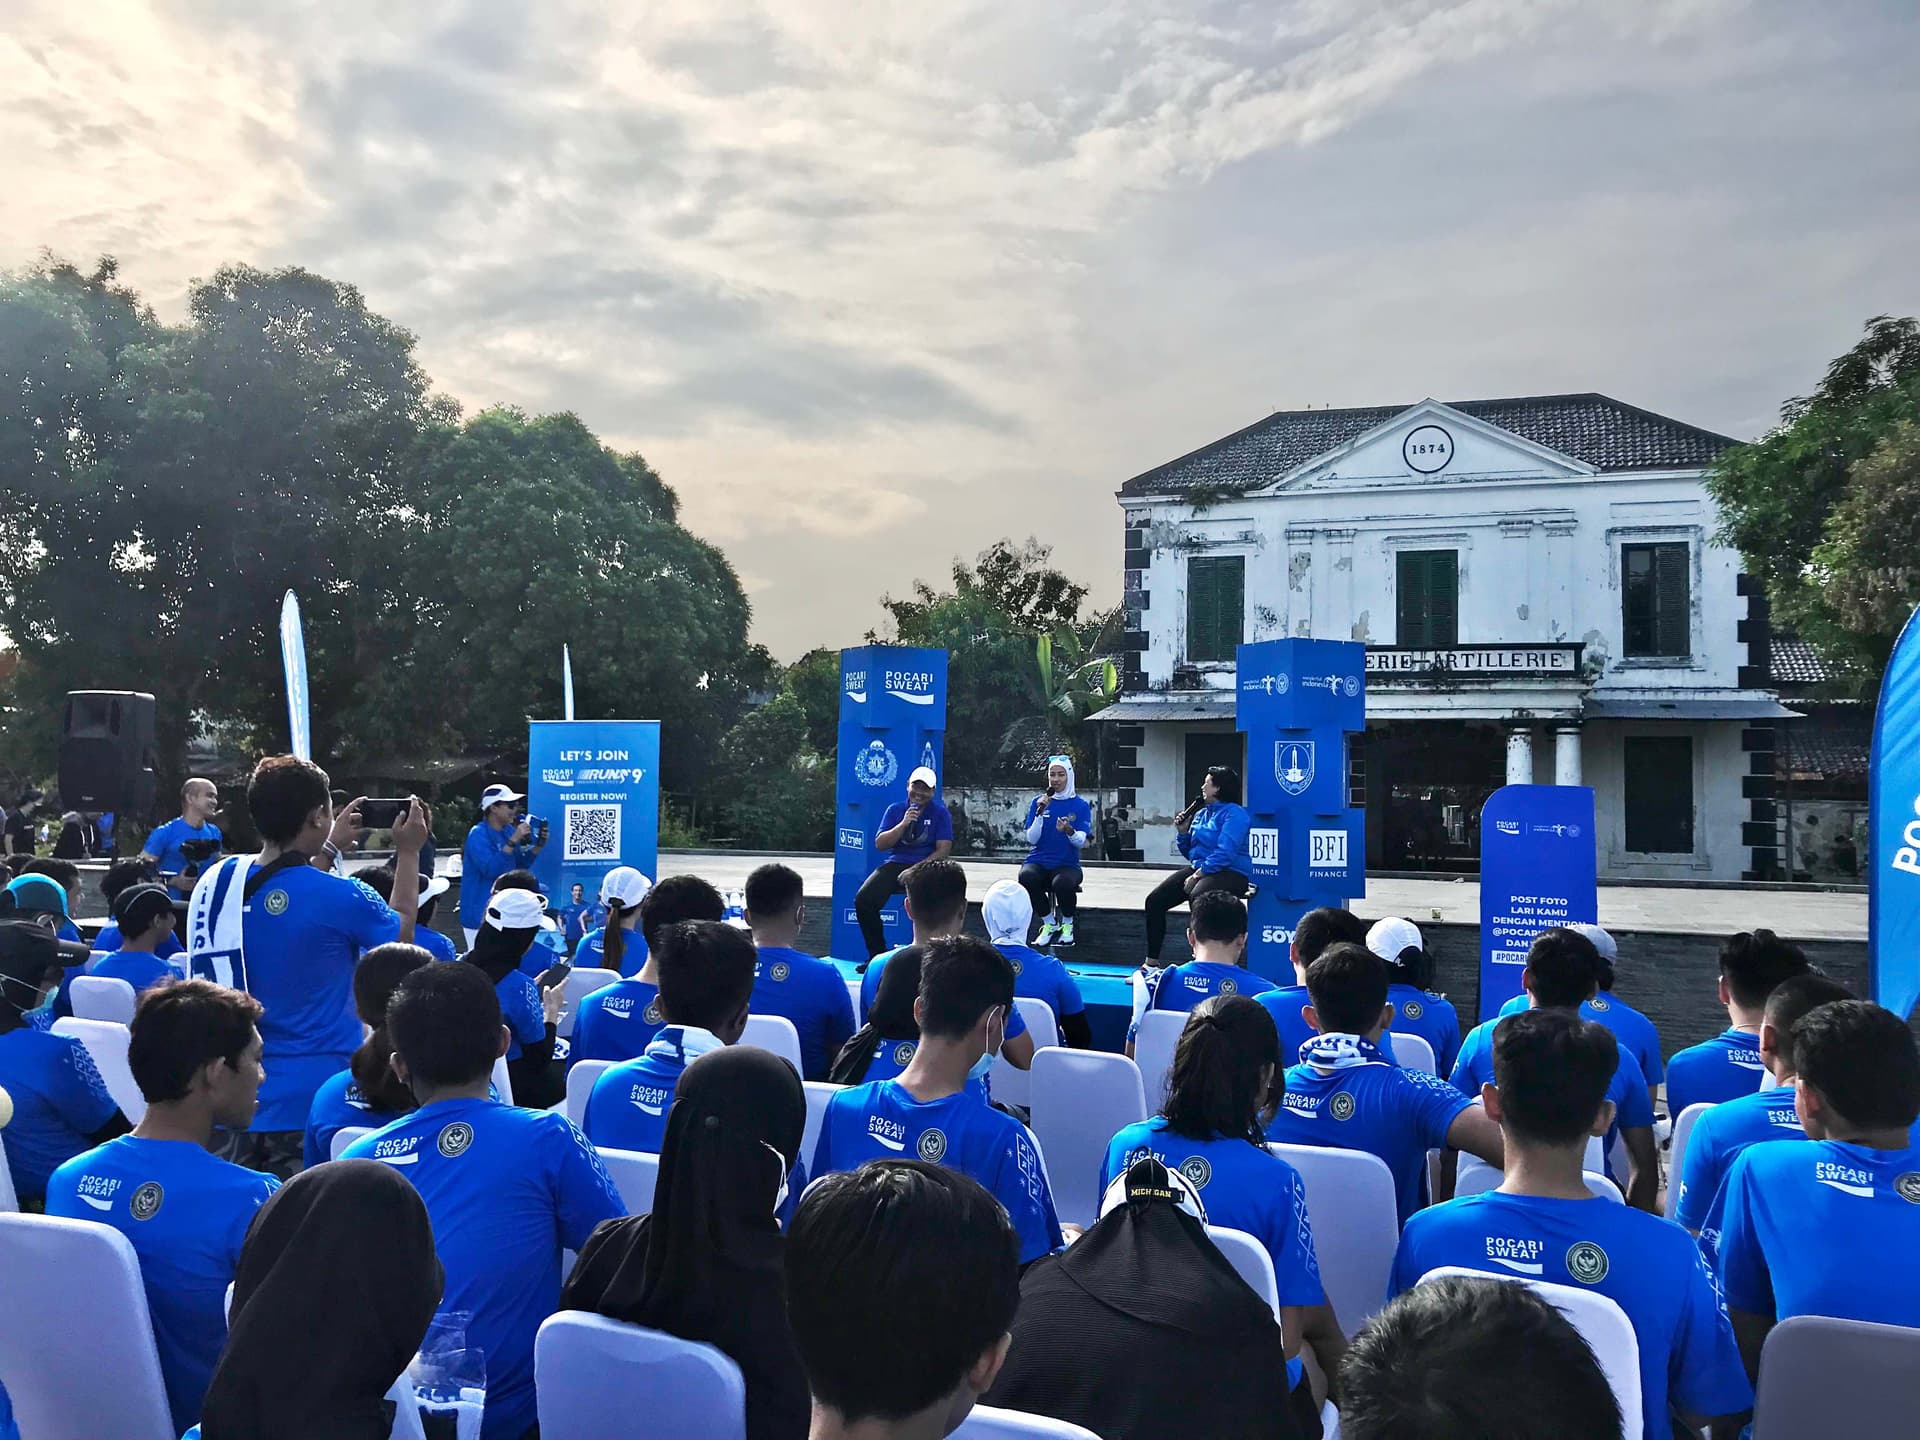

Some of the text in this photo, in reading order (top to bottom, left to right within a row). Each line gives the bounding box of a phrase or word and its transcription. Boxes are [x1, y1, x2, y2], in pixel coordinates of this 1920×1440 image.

[1412, 444, 1445, 454] 1874
[845, 671, 866, 681] POCARI
[885, 670, 933, 683] POCARI
[845, 680, 864, 690] SWEAT
[885, 680, 929, 691] SWEAT
[560, 751, 629, 761] LET'S JOIN
[1252, 834, 1277, 859] BFI
[1312, 836, 1345, 861] BFI
[1252, 868, 1279, 876] INANCE
[1511, 895, 1568, 906] POST FOTO
[1511, 906, 1568, 917] LARI KAMU
[1493, 916, 1536, 926] DENGAN
[1506, 939, 1529, 947] DAN
[1727, 1049, 1761, 1057] POCAR
[632, 1084, 667, 1098] POCARI
[630, 1092, 663, 1104] SWEAT
[1282, 1098, 1315, 1109] SWEAT
[1284, 1092, 1320, 1104] POCARI
[1768, 1110, 1795, 1118] POC
[868, 1123, 903, 1140] SWEAT
[376, 1136, 424, 1150] POCAR
[1815, 1161, 1874, 1182] POCARI
[80, 1175, 122, 1189] POCARI
[77, 1184, 115, 1197] SWEAT
[1131, 1188, 1172, 1198] MICHGAN
[1486, 1237, 1544, 1251] POCARI
[1486, 1246, 1539, 1260] SWEAT
